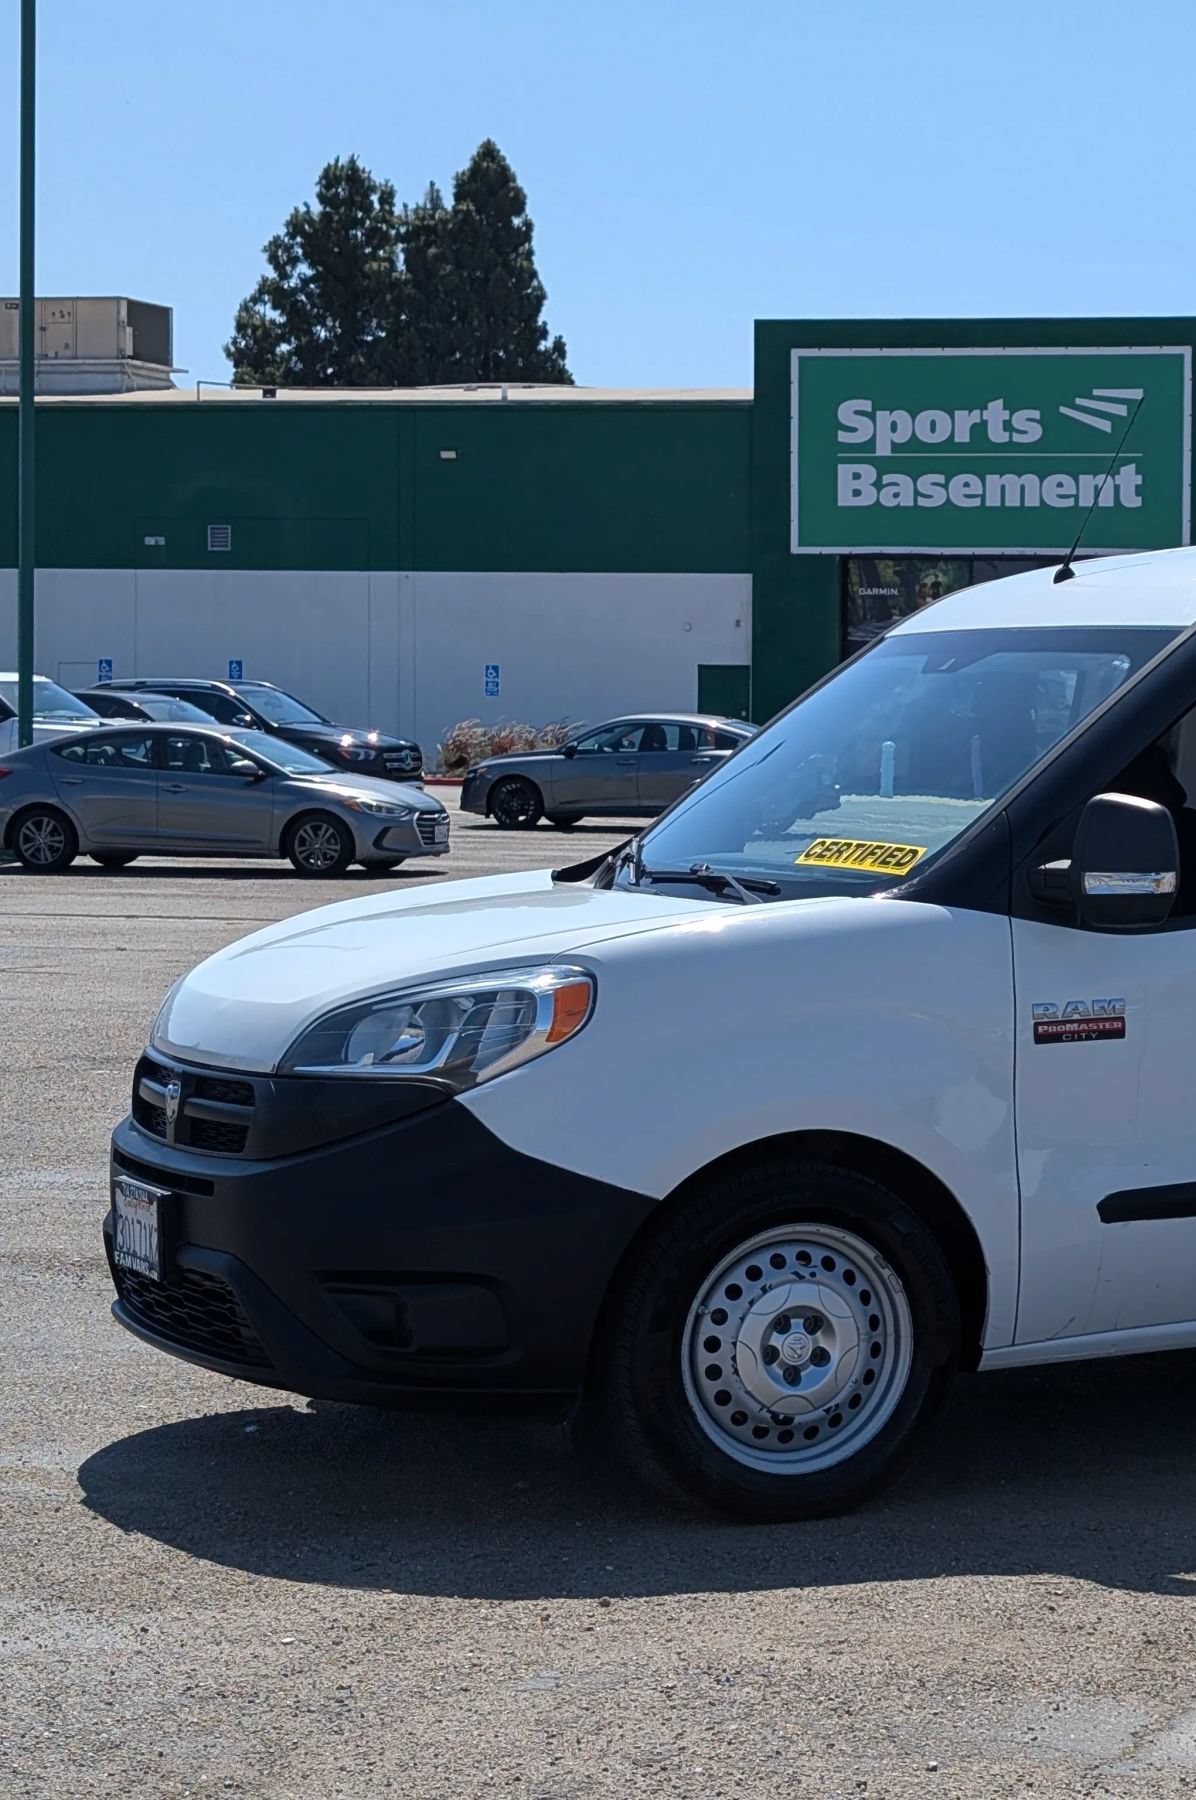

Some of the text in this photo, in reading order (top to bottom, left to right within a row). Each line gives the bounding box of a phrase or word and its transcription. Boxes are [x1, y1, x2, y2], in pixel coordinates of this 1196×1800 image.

[837, 398, 1043, 455] Sports
[837, 463, 1143, 508] Basement
[858, 587, 899, 596] GARMIN
[803, 840, 921, 870] CERTIFIED
[1032, 998, 1125, 1020] RAM
[1062, 1032, 1098, 1041] CITY
